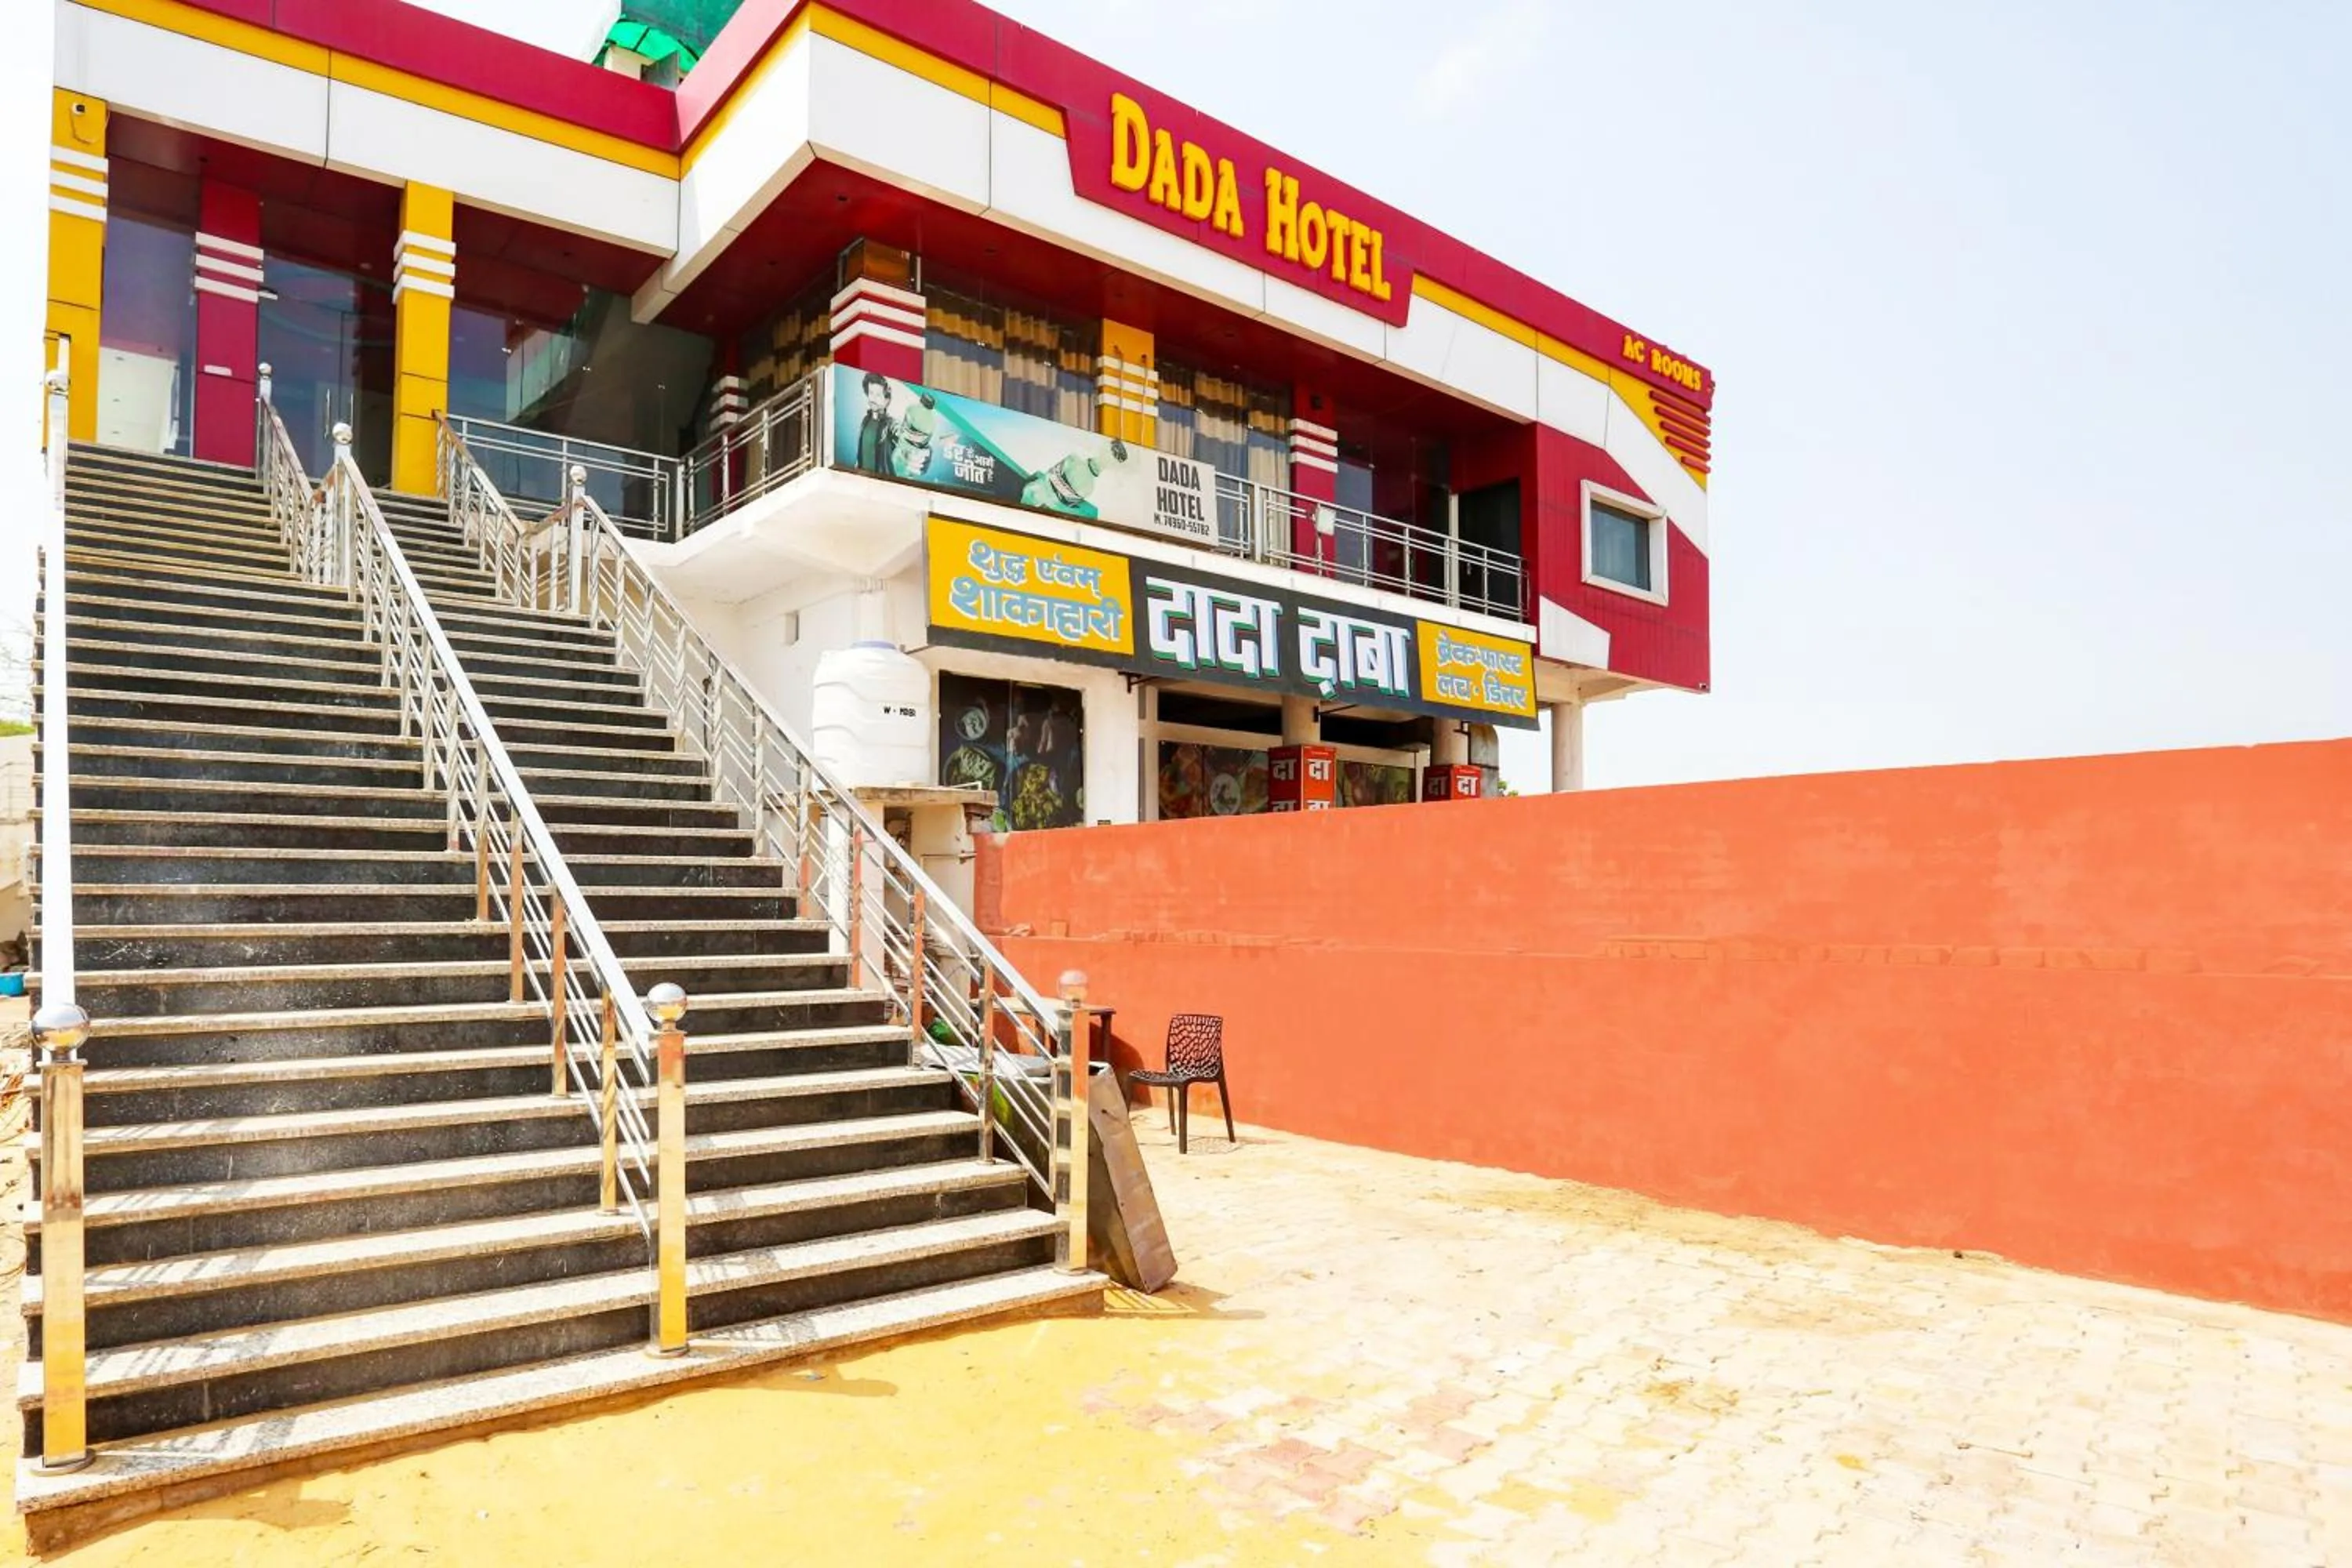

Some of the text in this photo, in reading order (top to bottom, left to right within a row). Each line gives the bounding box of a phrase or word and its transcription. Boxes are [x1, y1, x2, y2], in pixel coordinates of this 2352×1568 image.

[1111, 92, 1392, 301] DADA HOTEL
[1622, 334, 1701, 391] AC ROOMS
[1157, 456, 1201, 492] DADA
[1157, 485, 1205, 521] HOTEL
[968, 539, 1029, 586] शुद्ध
[949, 576, 1124, 642] शाकाहारी
[1146, 577, 1283, 679] दादा
[1272, 758, 1298, 781] दा
[1307, 758, 1332, 782] दा
[1456, 775, 1479, 797] दा
